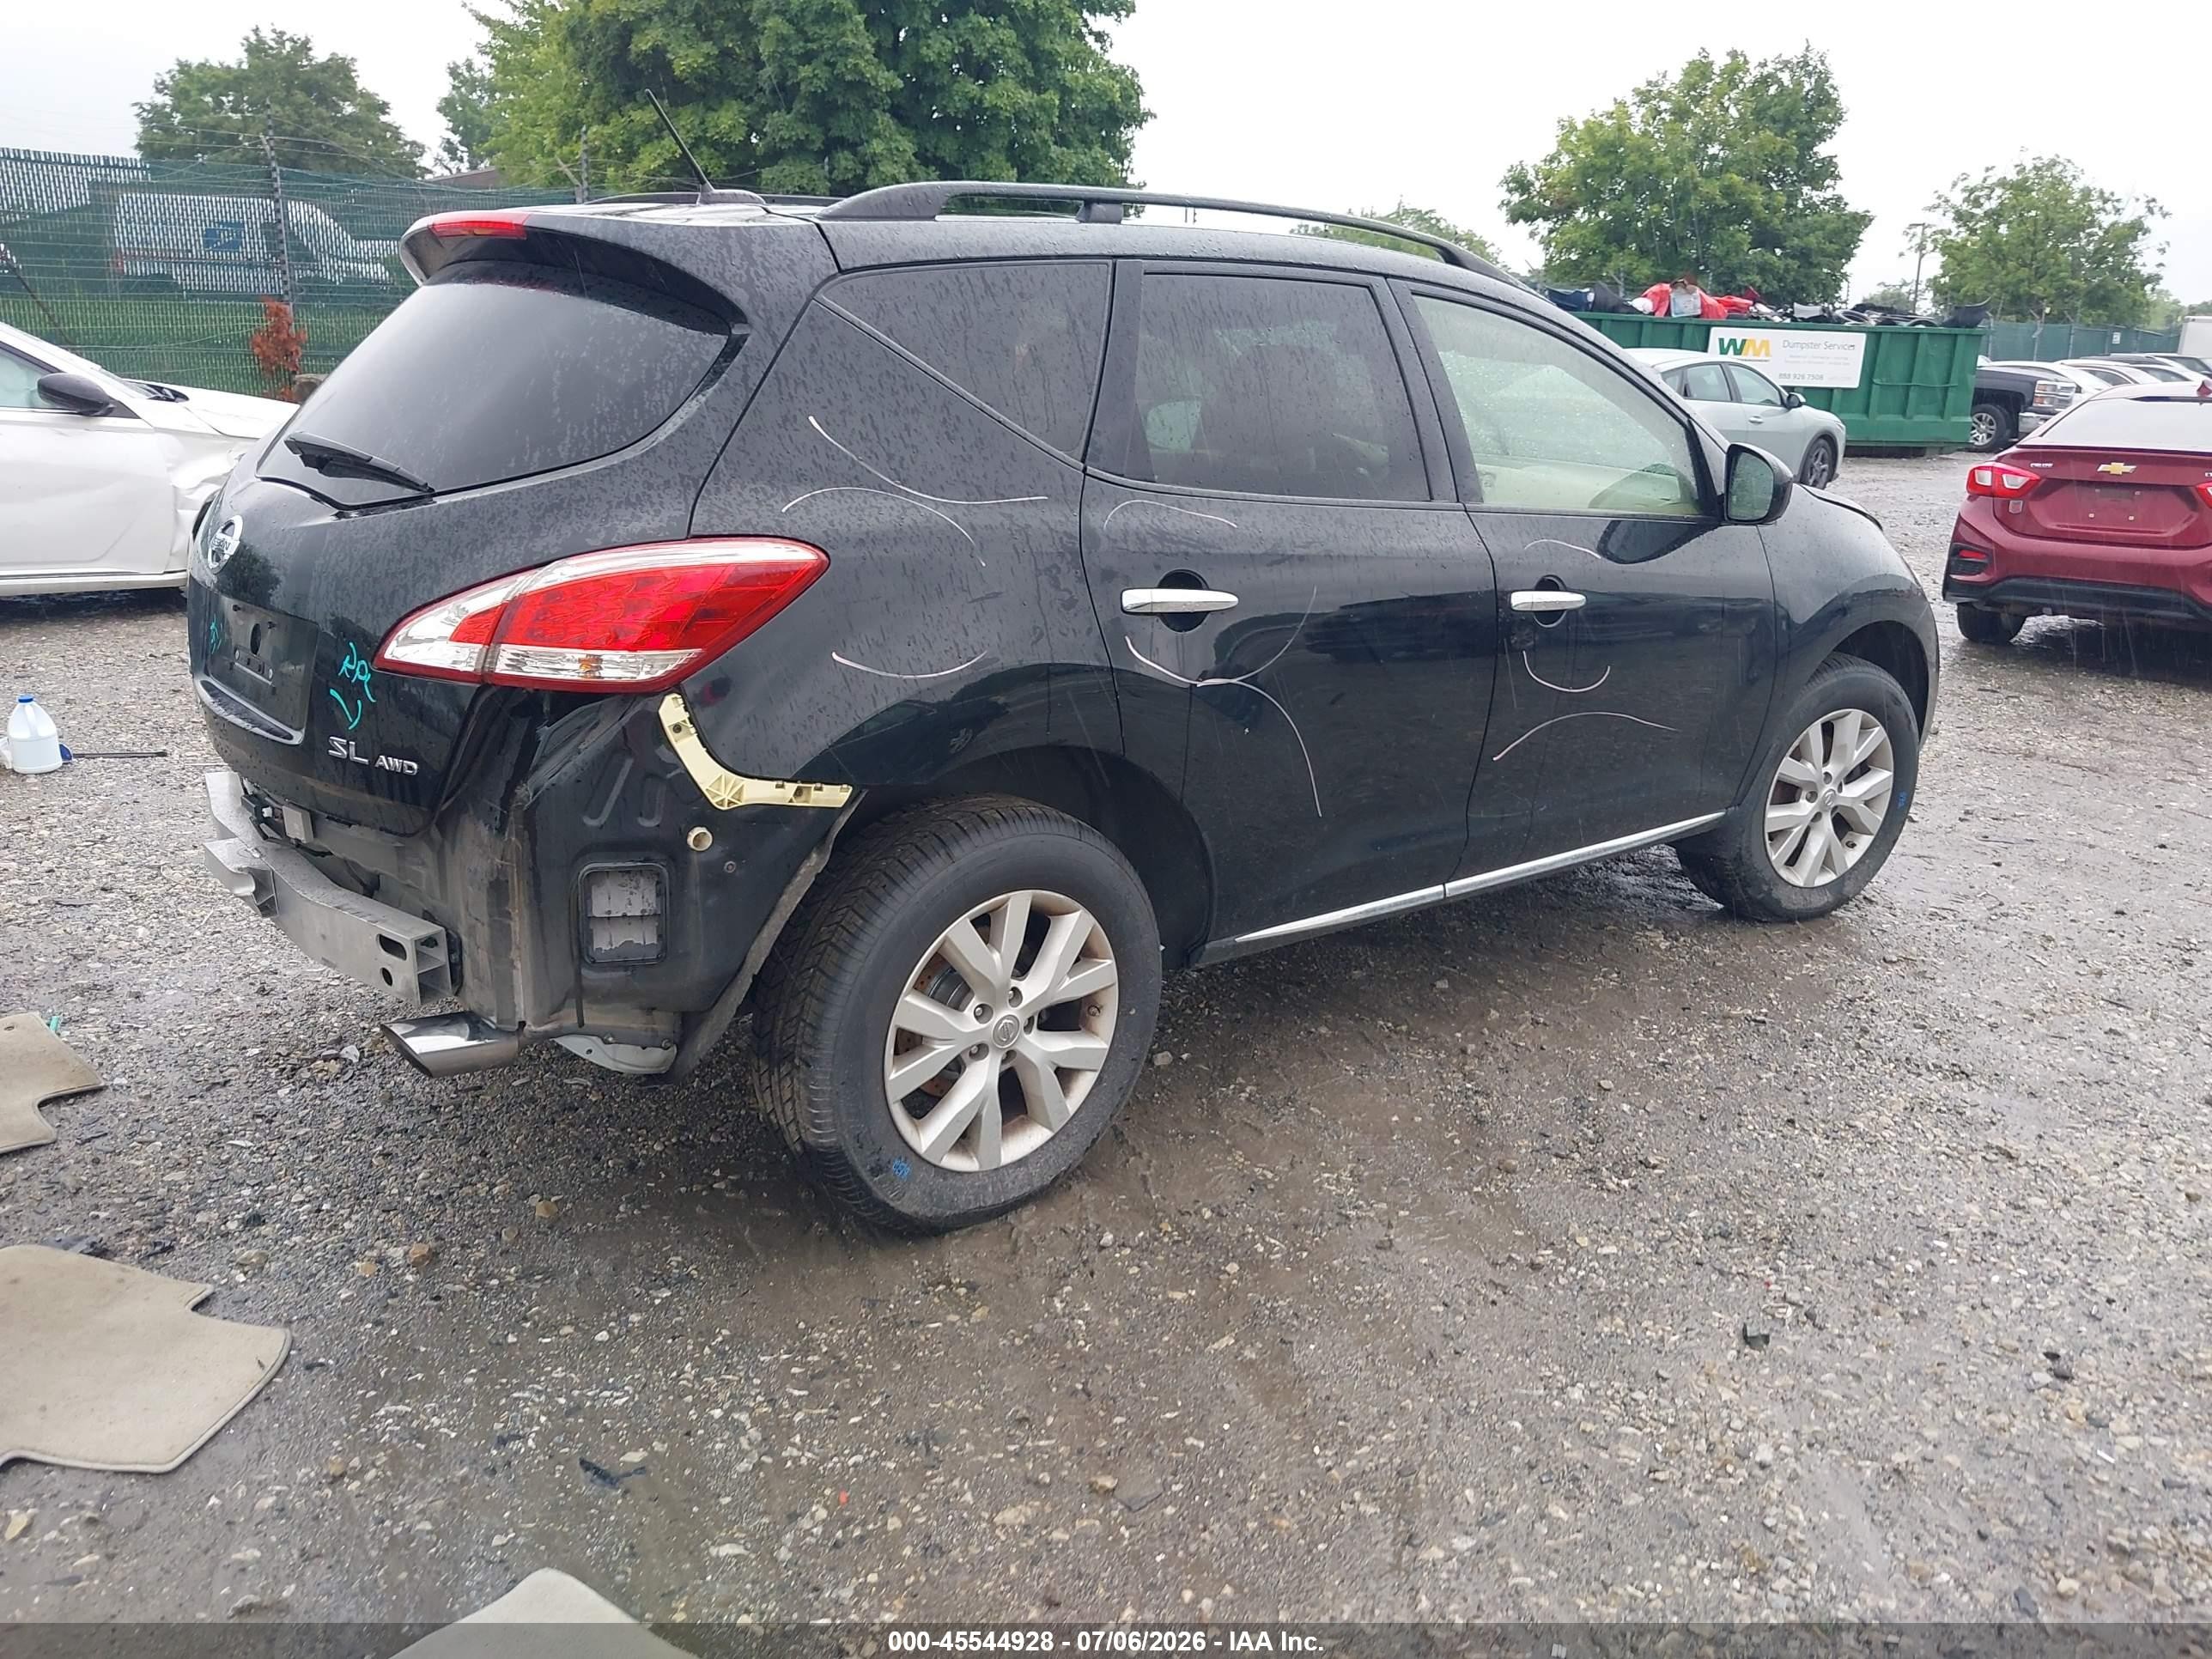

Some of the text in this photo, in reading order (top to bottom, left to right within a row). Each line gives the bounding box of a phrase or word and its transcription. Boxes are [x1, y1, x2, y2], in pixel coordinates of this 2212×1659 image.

[1718, 337, 1771, 357] WM
[1782, 340, 1820, 350] Dumpster
[328, 736, 418, 776] SL AWD
